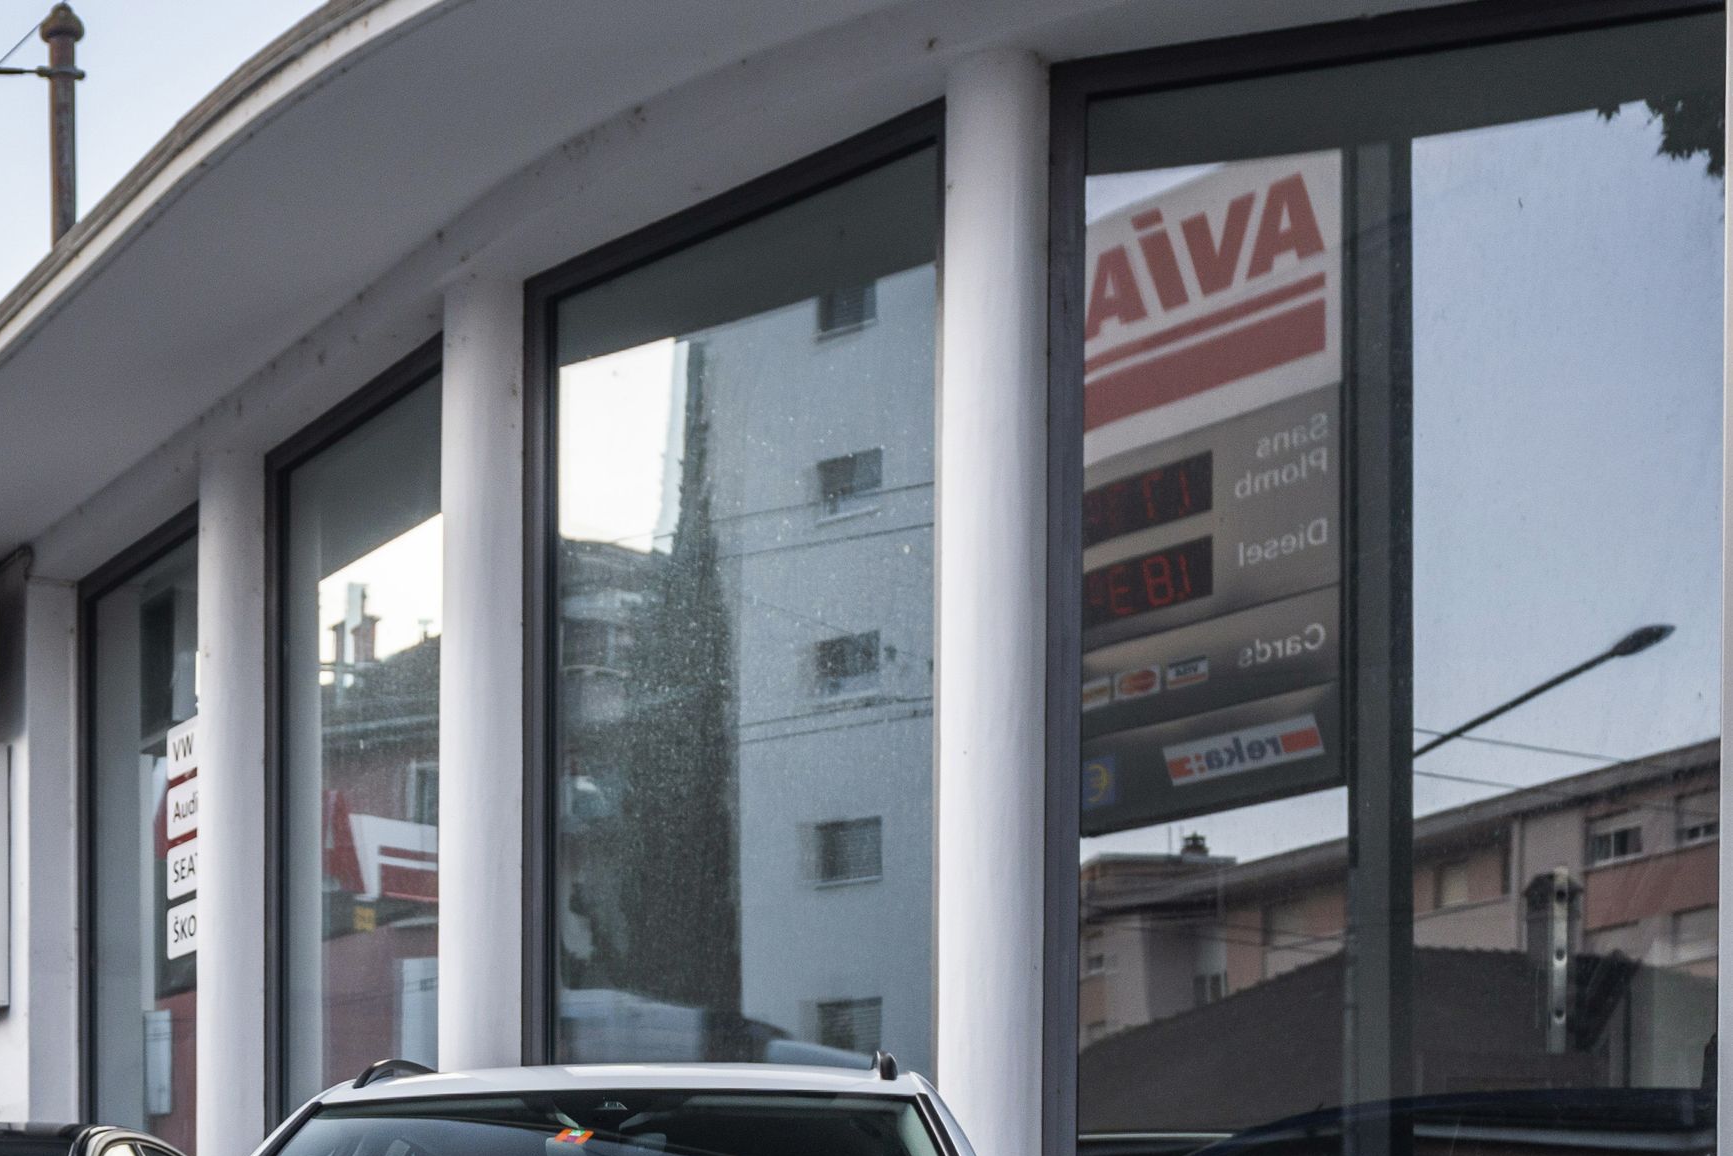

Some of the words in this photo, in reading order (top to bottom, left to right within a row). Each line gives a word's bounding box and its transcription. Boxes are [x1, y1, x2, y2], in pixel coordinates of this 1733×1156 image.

[172, 732, 195, 762] VW
[173, 852, 198, 884] SEA
[173, 909, 197, 944] ŠKO
